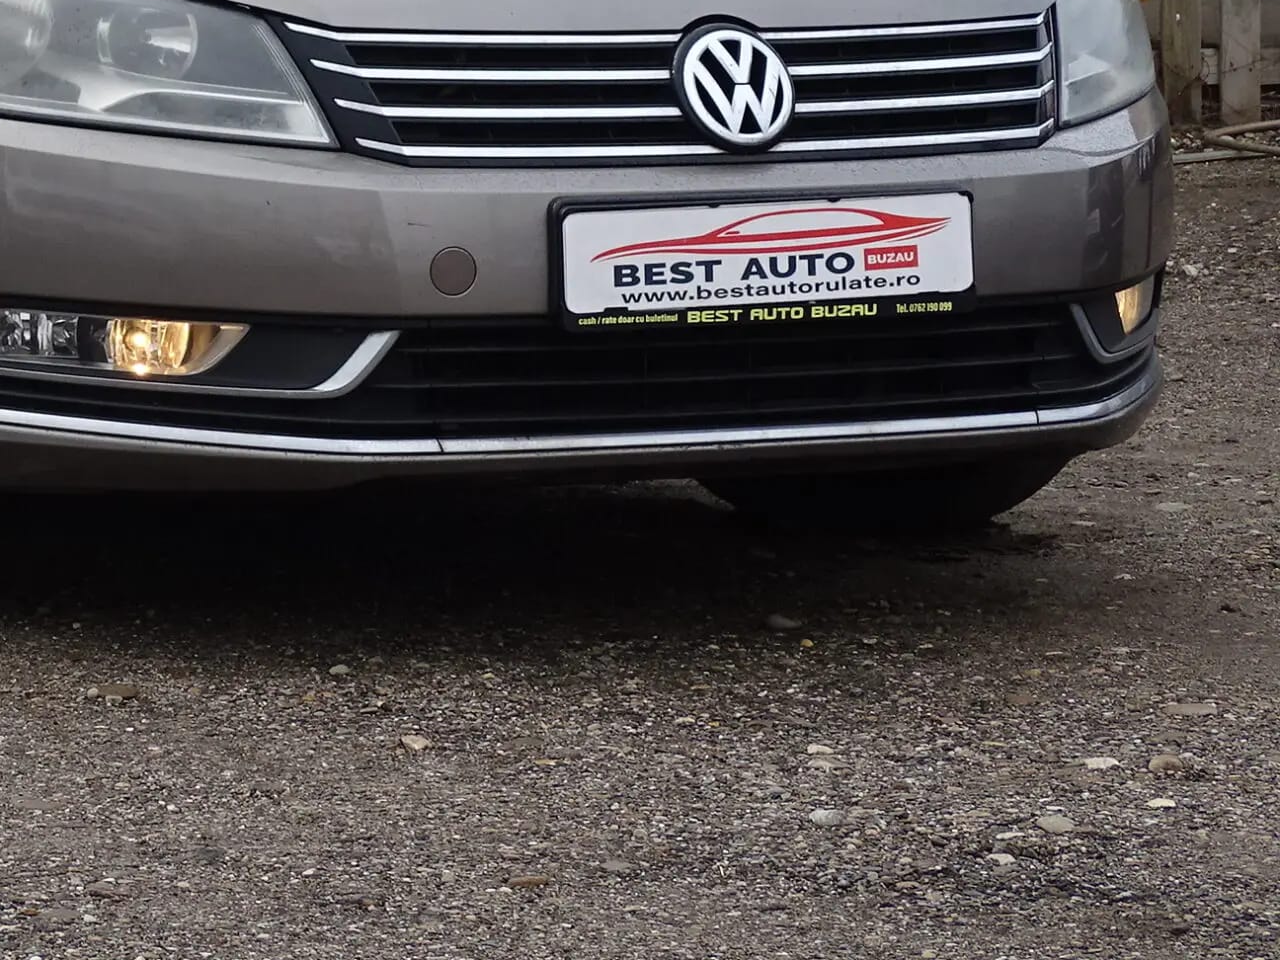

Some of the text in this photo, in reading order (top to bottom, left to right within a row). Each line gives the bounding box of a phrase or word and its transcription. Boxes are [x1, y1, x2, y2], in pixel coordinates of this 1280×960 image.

[613, 252, 914, 288] BEST AUTO BUZAU
[622, 275, 920, 304] www.bestautorulate.ro
[578, 316, 597, 325] cash
[687, 304, 878, 323] BEST AUTO BUZAU
